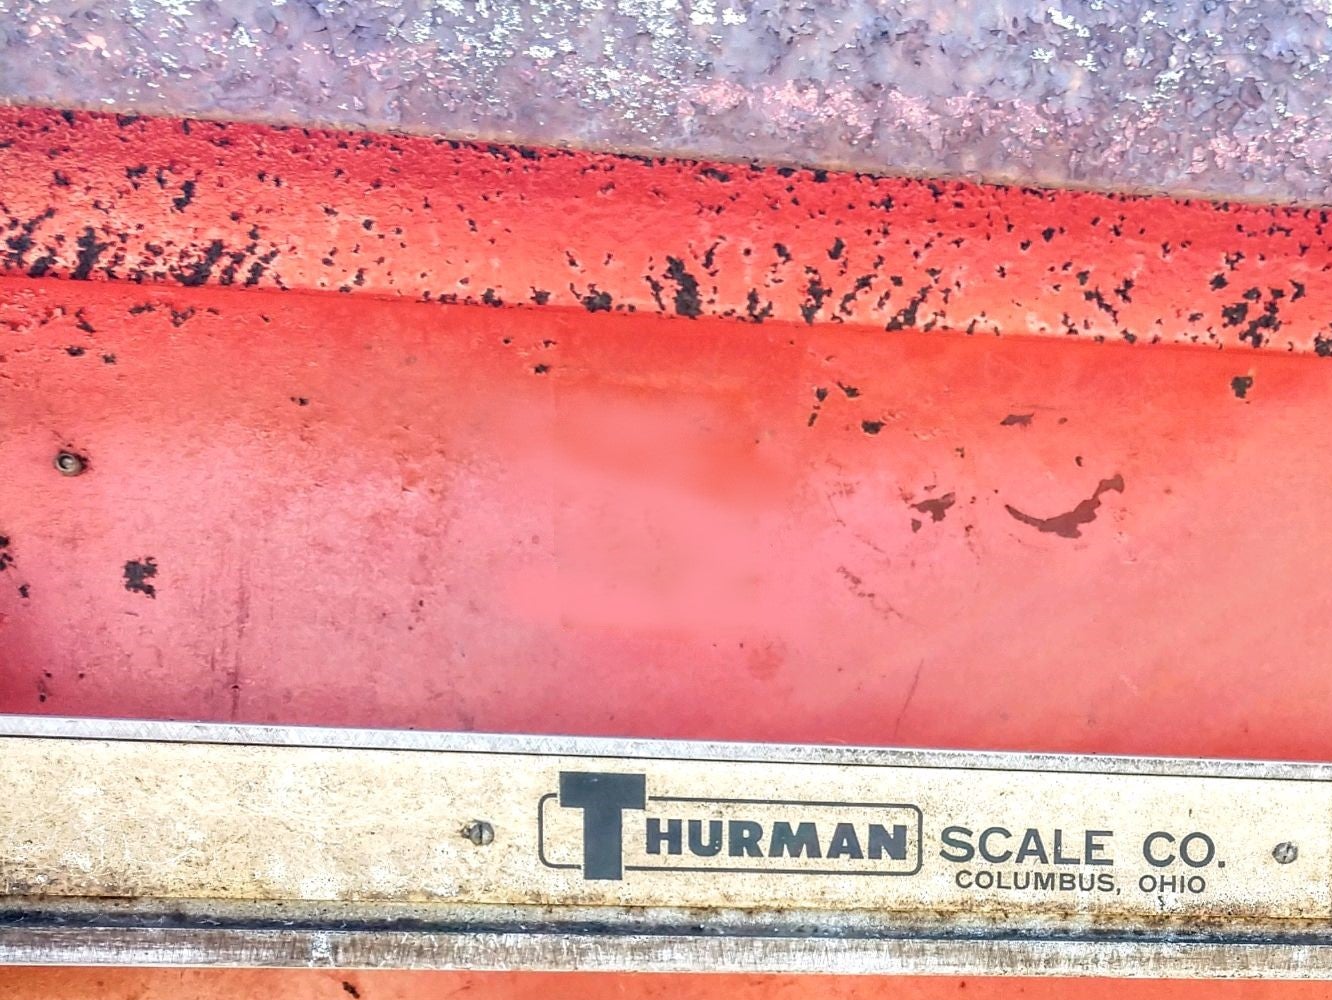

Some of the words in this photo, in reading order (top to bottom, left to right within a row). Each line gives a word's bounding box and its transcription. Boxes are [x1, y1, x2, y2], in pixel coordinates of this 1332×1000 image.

[559, 771, 907, 880] THURMAN
[939, 826, 1114, 867] SCALE
[1142, 831, 1226, 869] CO.
[955, 870, 1121, 896] COLUMBUS,
[1139, 874, 1206, 894] OHIO
